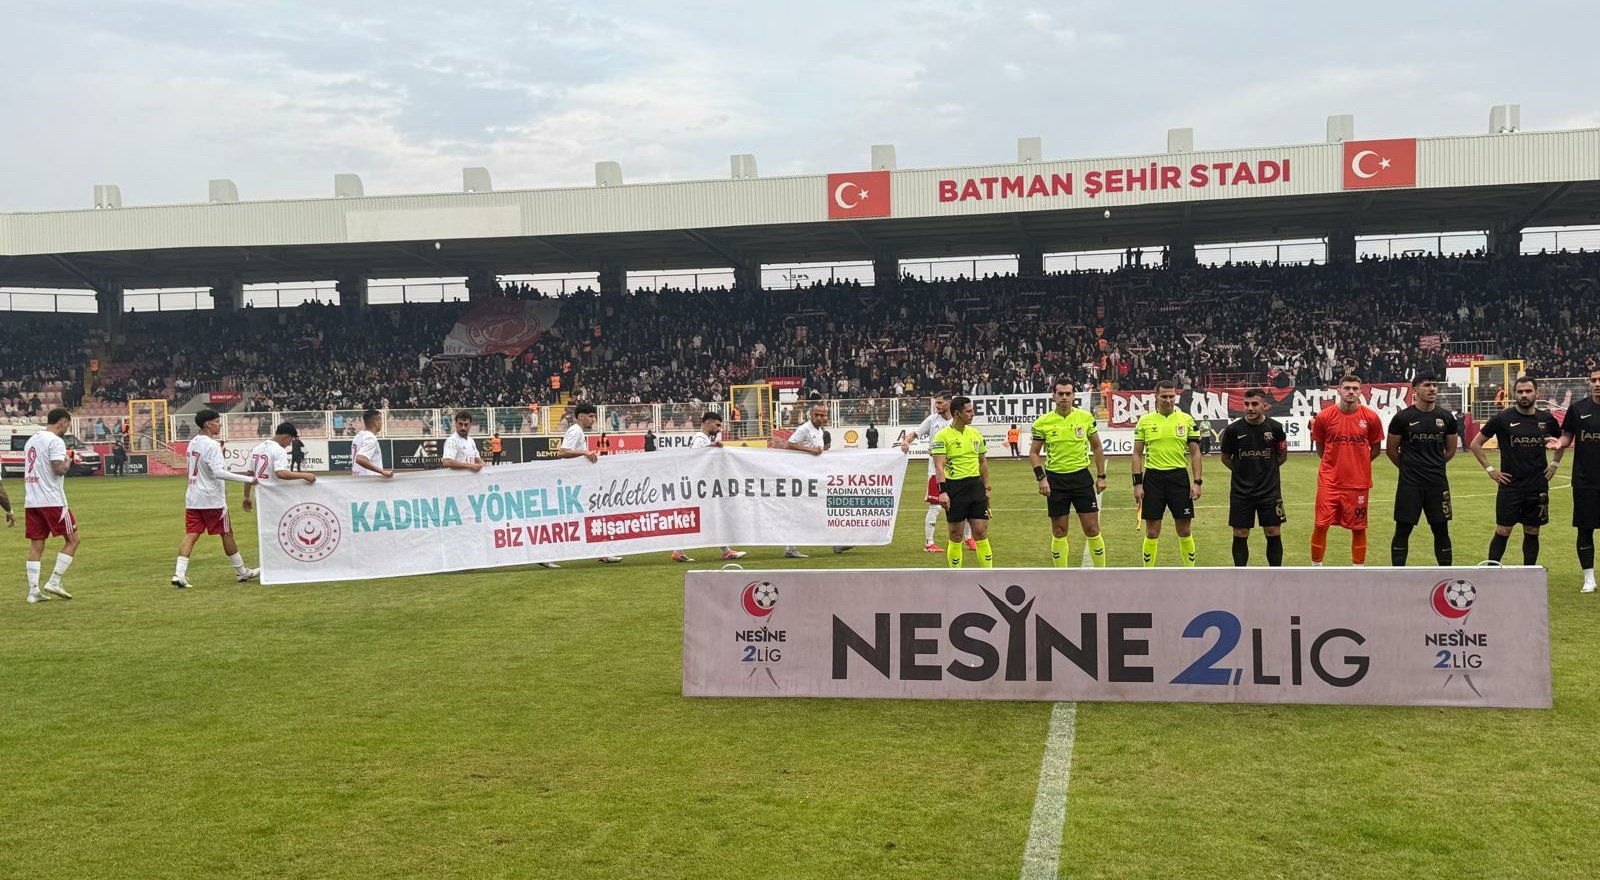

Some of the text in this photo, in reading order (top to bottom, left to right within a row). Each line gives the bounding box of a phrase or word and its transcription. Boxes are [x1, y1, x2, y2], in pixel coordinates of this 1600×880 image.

[938, 158, 1291, 203] BATMAN ŞEHİR STADI
[973, 396, 1019, 416] ERİT
[658, 436, 695, 448] EN PLA
[1113, 439, 1132, 452] LİG
[27, 446, 37, 473] 9
[826, 474, 894, 487] 25 KASIM
[827, 486, 893, 496] KADINA YÖNELİK
[351, 496, 463, 533] KADINA
[467, 479, 585, 523] YÖNELİK
[588, 476, 659, 513] şiddetle
[661, 476, 819, 501] MÜCADELEDE
[827, 497, 894, 508] ŞİDDETE KARŞI
[827, 508, 894, 517] ULUSLARARASI
[1354, 507, 1366, 519] 99
[494, 510, 696, 549] BİZ VARIZ #işaretiFarket
[827, 518, 870, 528] MÜCADELE
[735, 626, 787, 643] NESİNE
[832, 584, 1154, 683] NESİNE
[1252, 615, 1371, 688] LİG
[1424, 629, 1488, 647] NESİNE
[757, 646, 782, 662] LİG
[1453, 651, 1483, 669] LİG
